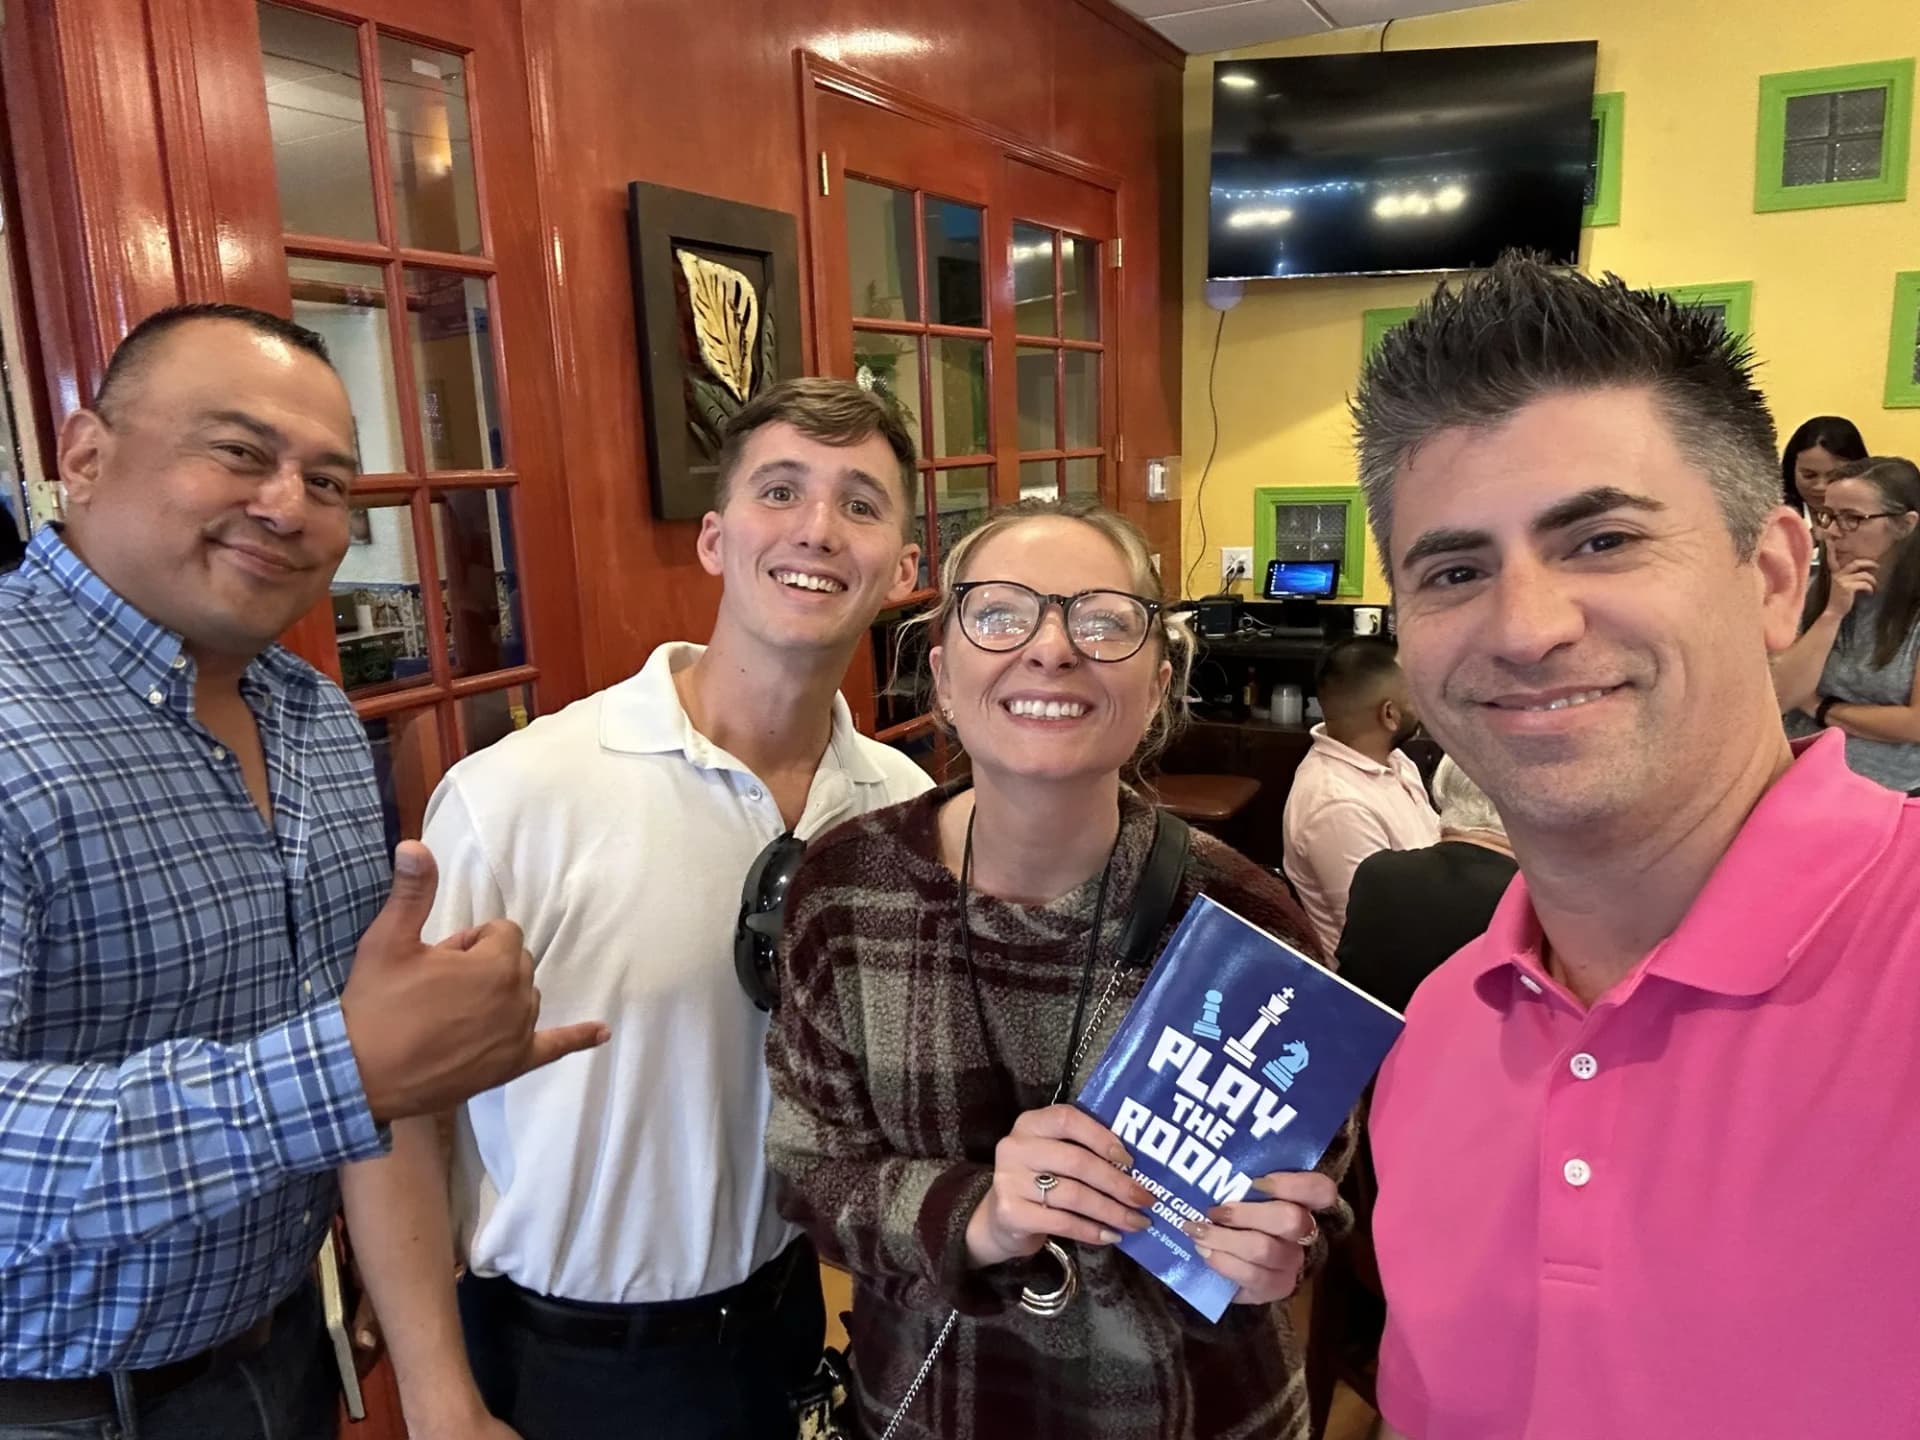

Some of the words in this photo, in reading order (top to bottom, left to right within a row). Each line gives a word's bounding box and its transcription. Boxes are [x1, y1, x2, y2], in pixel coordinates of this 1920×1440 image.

[1147, 1025, 1298, 1141] PLAY
[1171, 1092, 1235, 1147] THE
[1111, 1097, 1253, 1204] ROOM
[1131, 1168, 1174, 1202] SHORT
